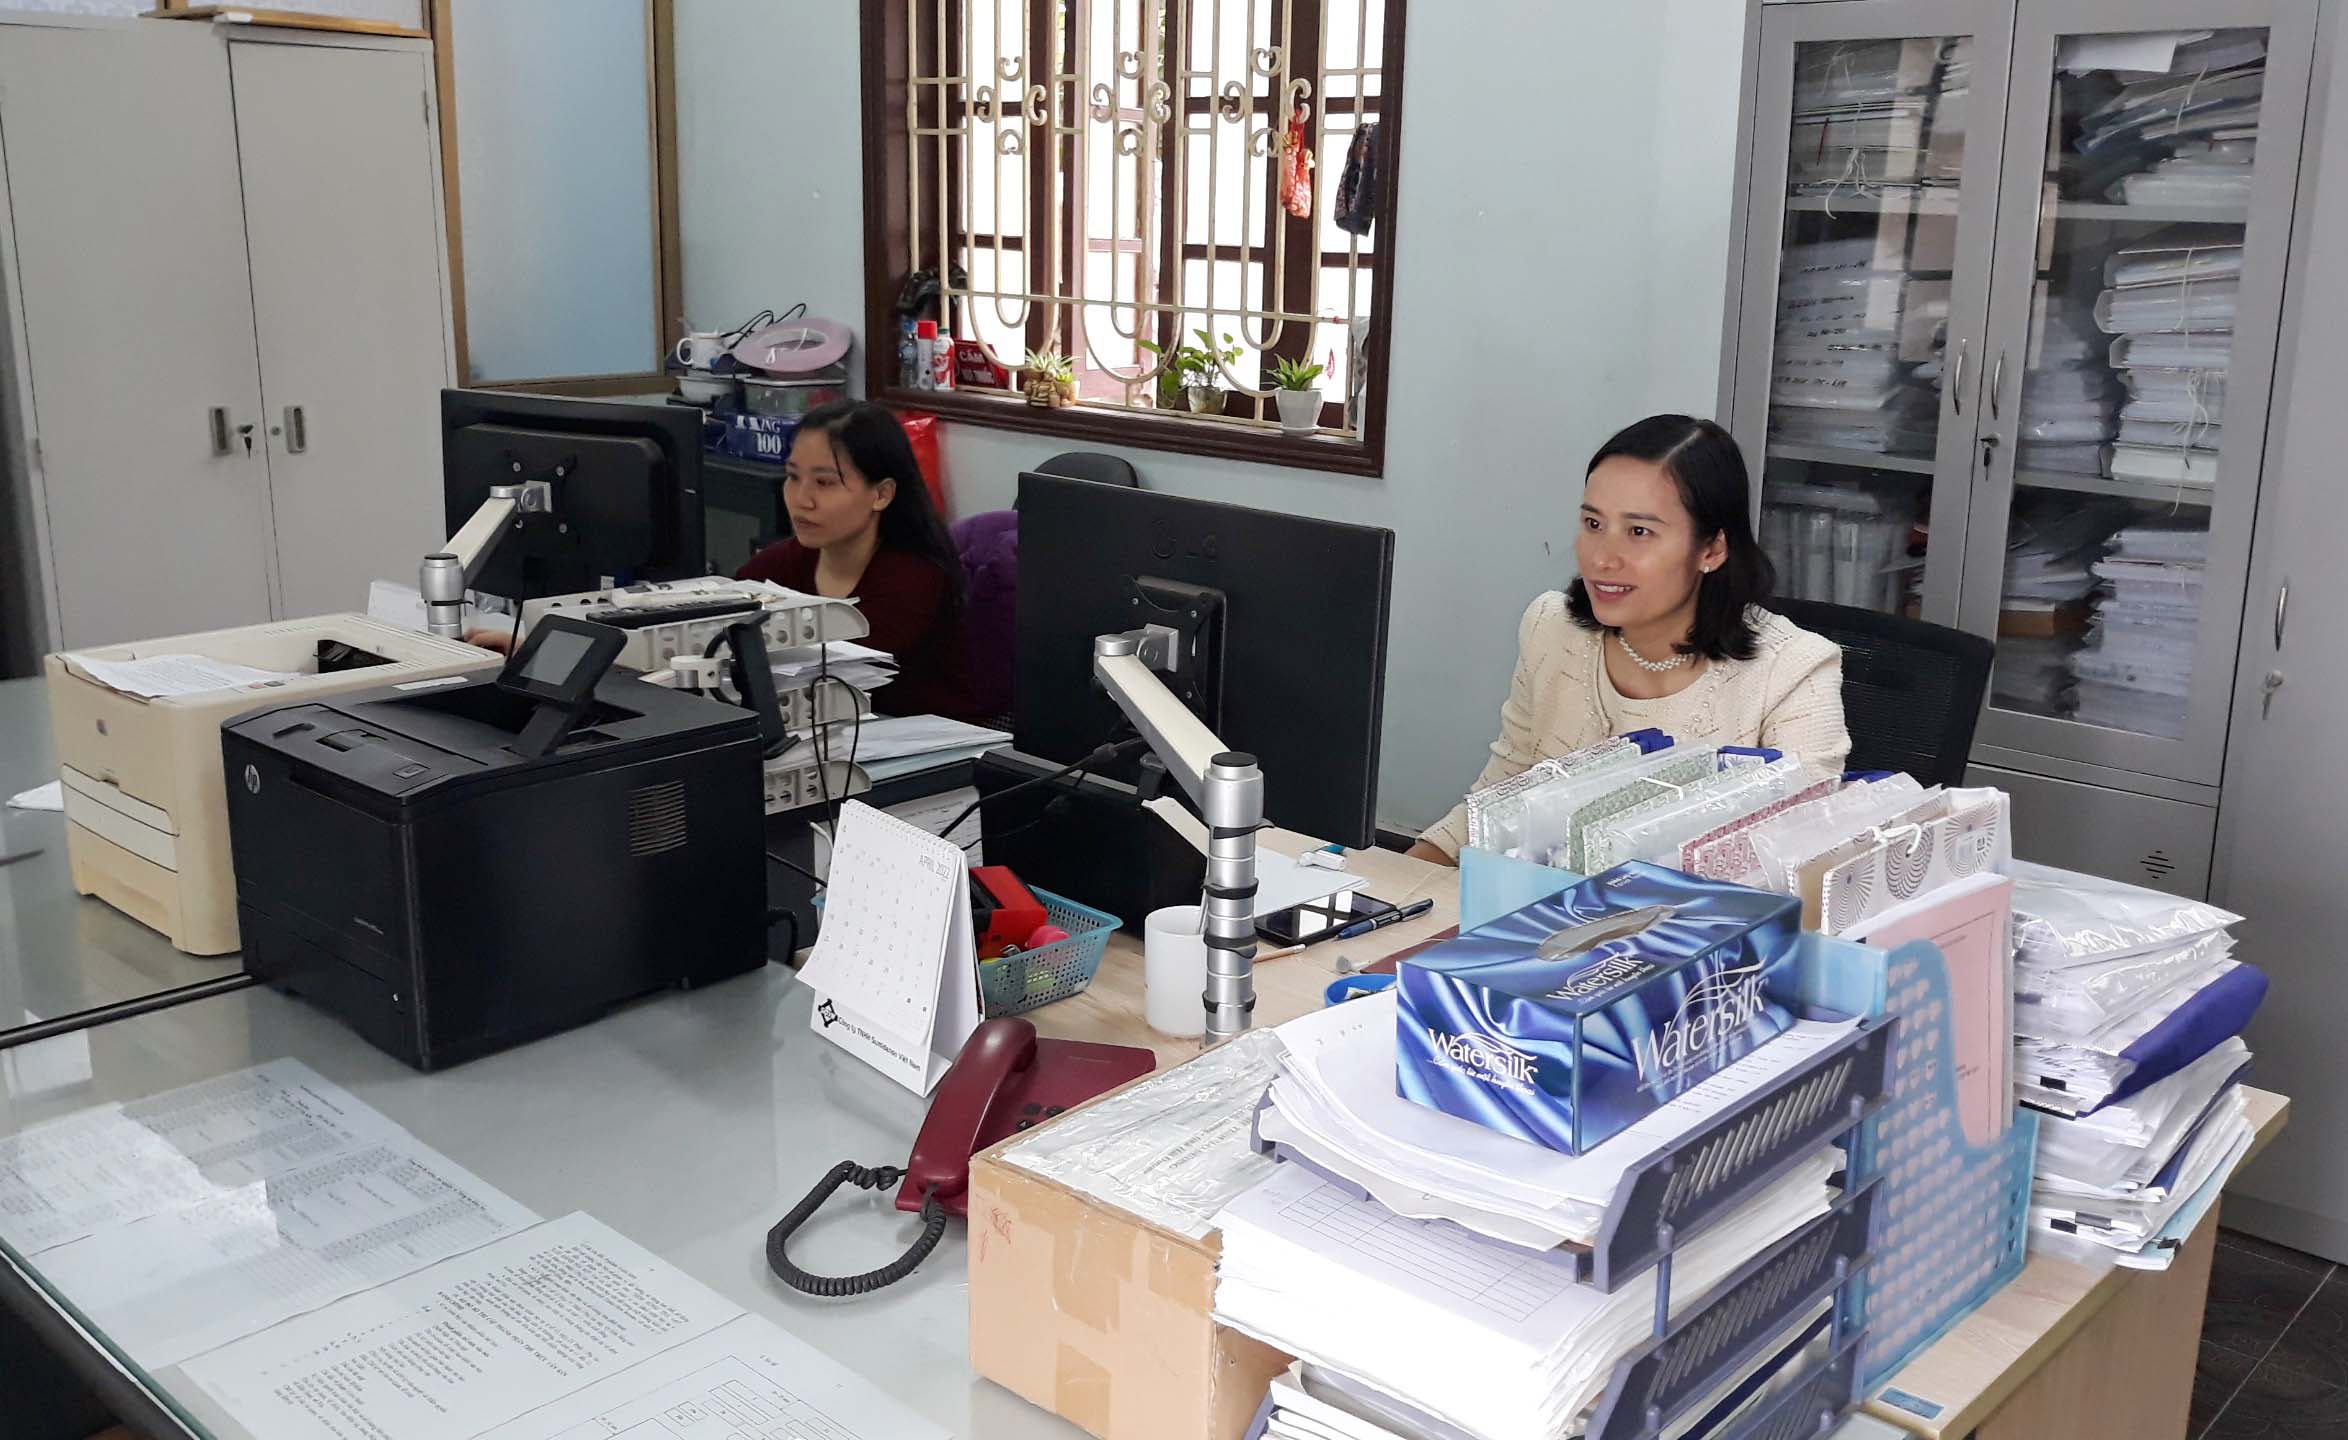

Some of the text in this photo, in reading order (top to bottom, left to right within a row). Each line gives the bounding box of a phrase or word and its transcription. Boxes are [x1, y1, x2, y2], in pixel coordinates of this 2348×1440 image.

[756, 432, 782, 454] 100
[1545, 953, 1643, 1000] Watersilk
[1632, 973, 1769, 1081] Watersilk
[1427, 1027, 1538, 1084] Watersilk
